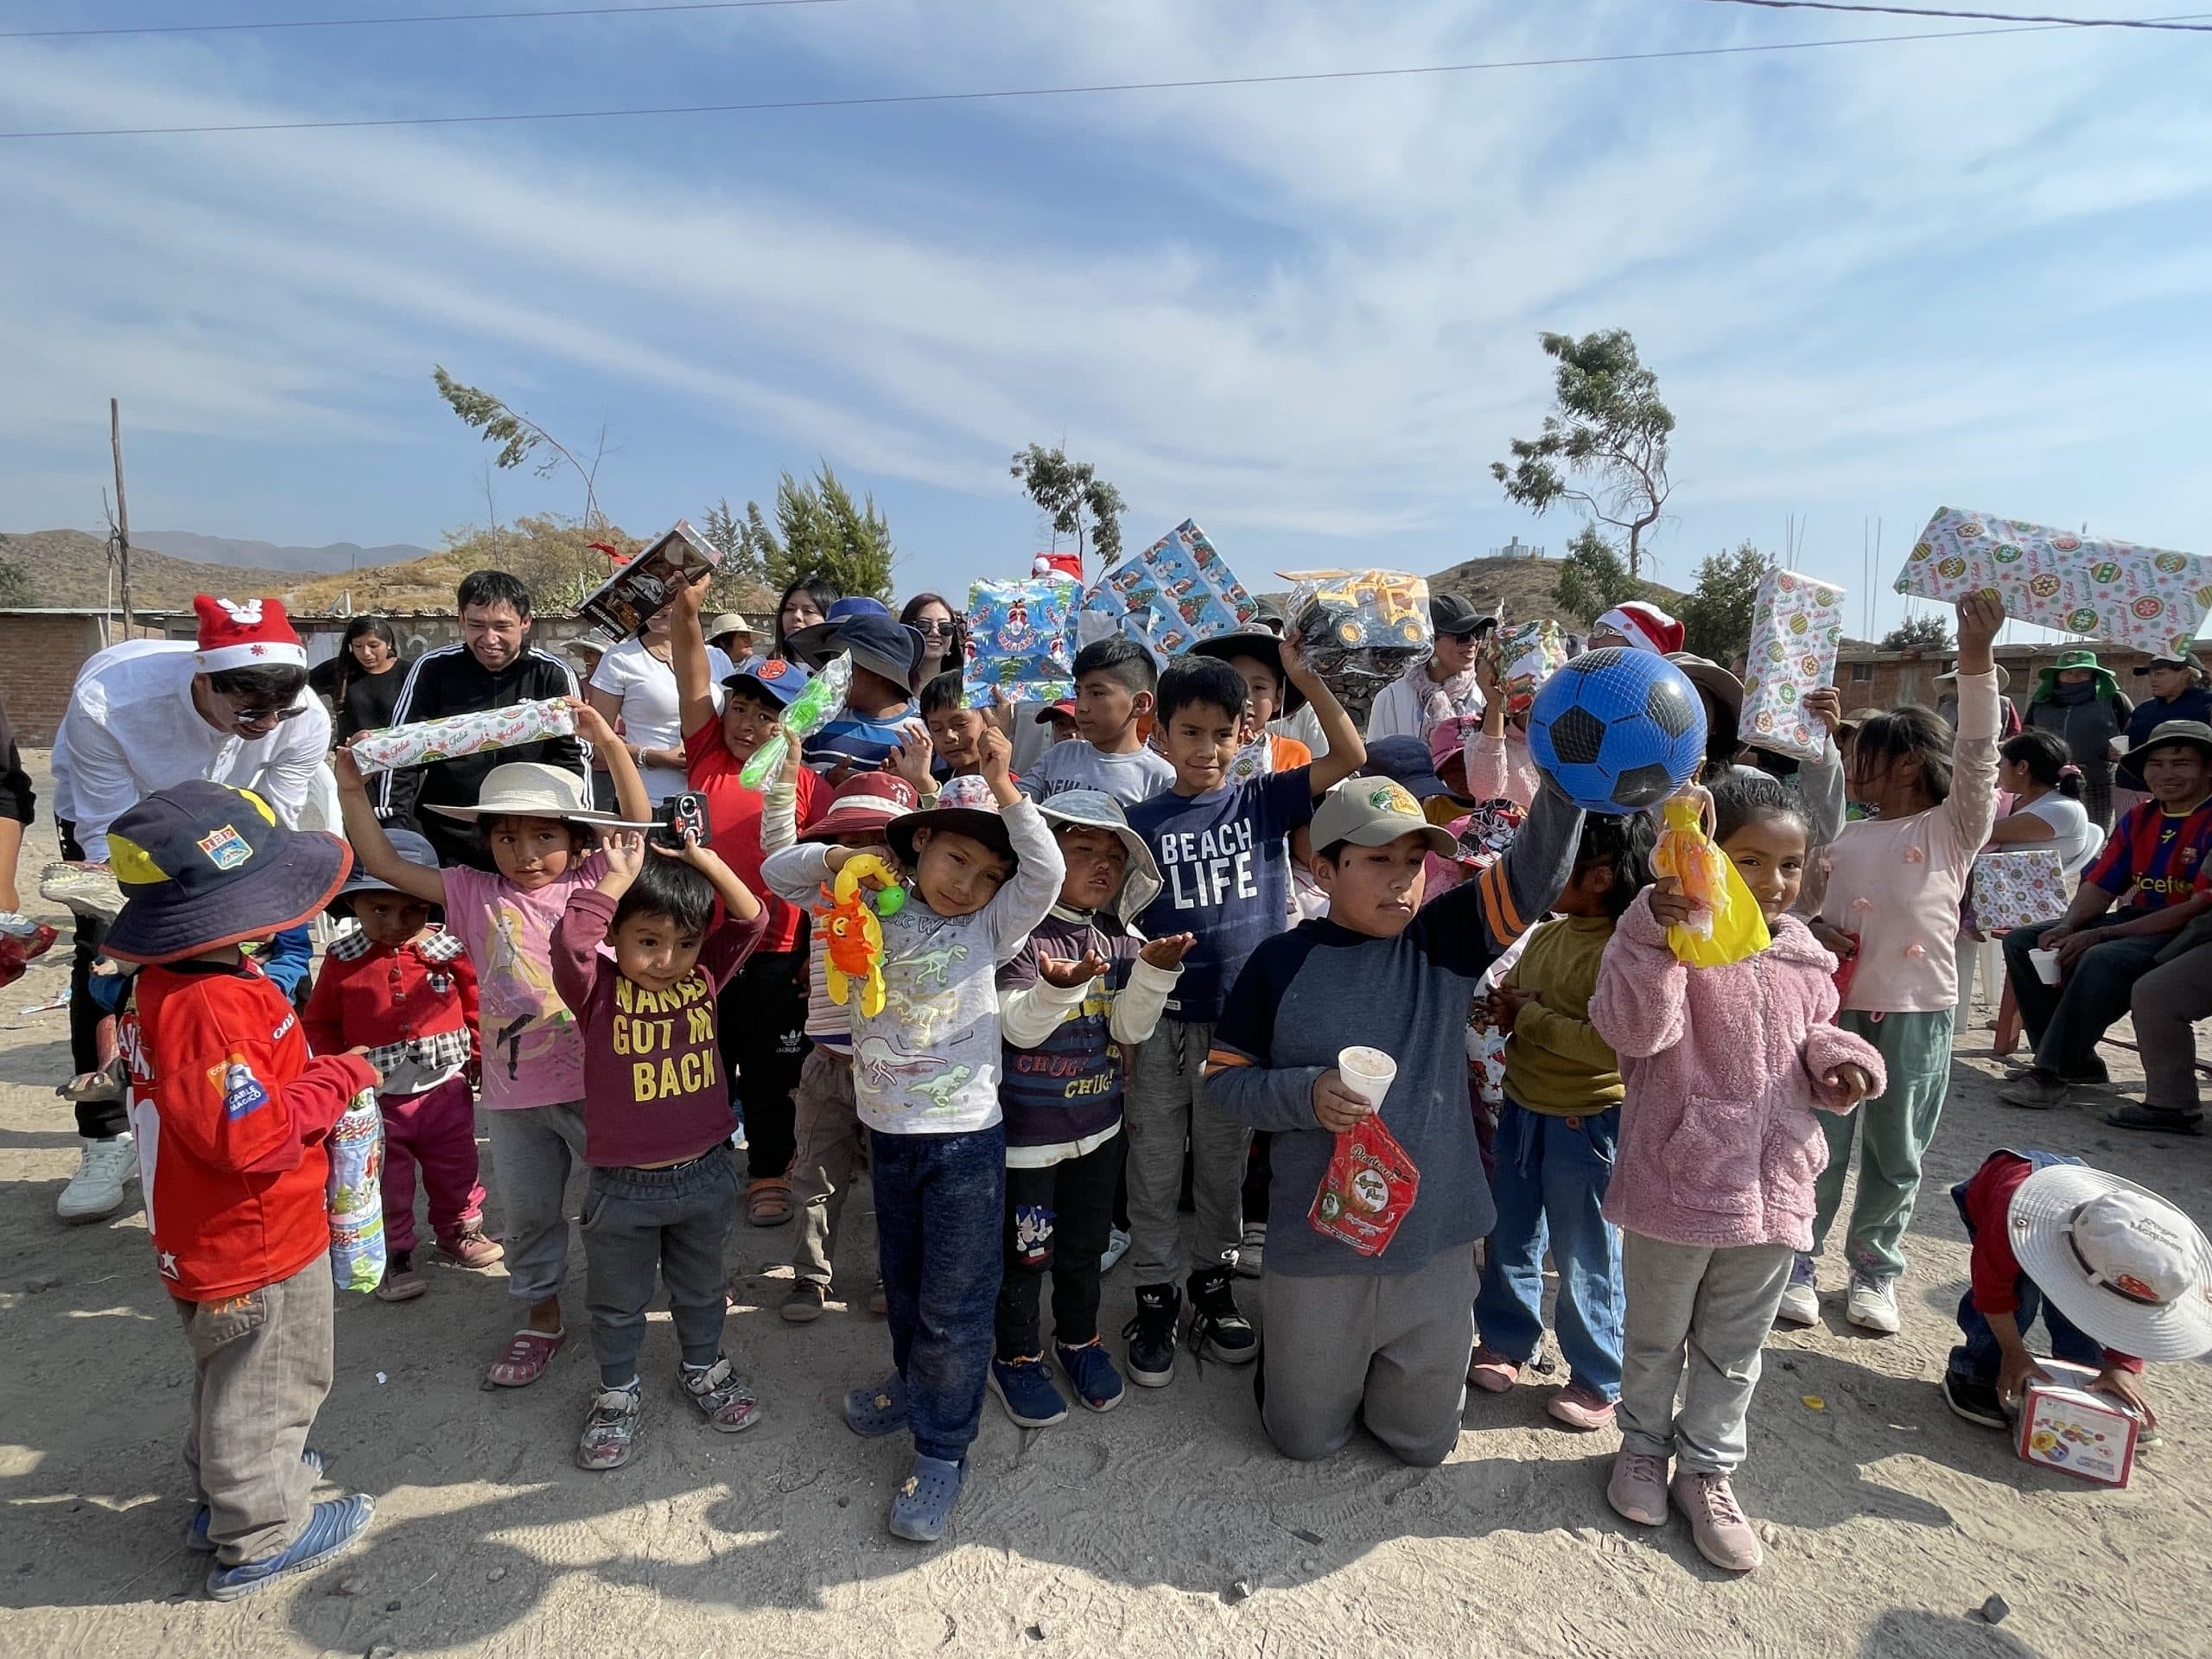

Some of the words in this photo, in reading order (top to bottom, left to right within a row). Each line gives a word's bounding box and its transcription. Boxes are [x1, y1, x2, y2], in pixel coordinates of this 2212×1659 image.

[448, 730, 469, 748] Feliz
[505, 721, 526, 739] Feliz
[390, 739, 411, 758] Feliz
[1161, 817, 1253, 865] BEACH
[1170, 851, 1258, 910] LIFE
[2132, 872, 2172, 893] icef
[613, 1014, 675, 1055] GOT
[687, 1001, 715, 1045] M
[210, 1060, 230, 1077] COP
[632, 1047, 716, 1103] BACK
[1017, 1054, 1090, 1077] CHUG!
[229, 1085, 257, 1104] CABLE
[1065, 1068, 1116, 1099] CHUG!
